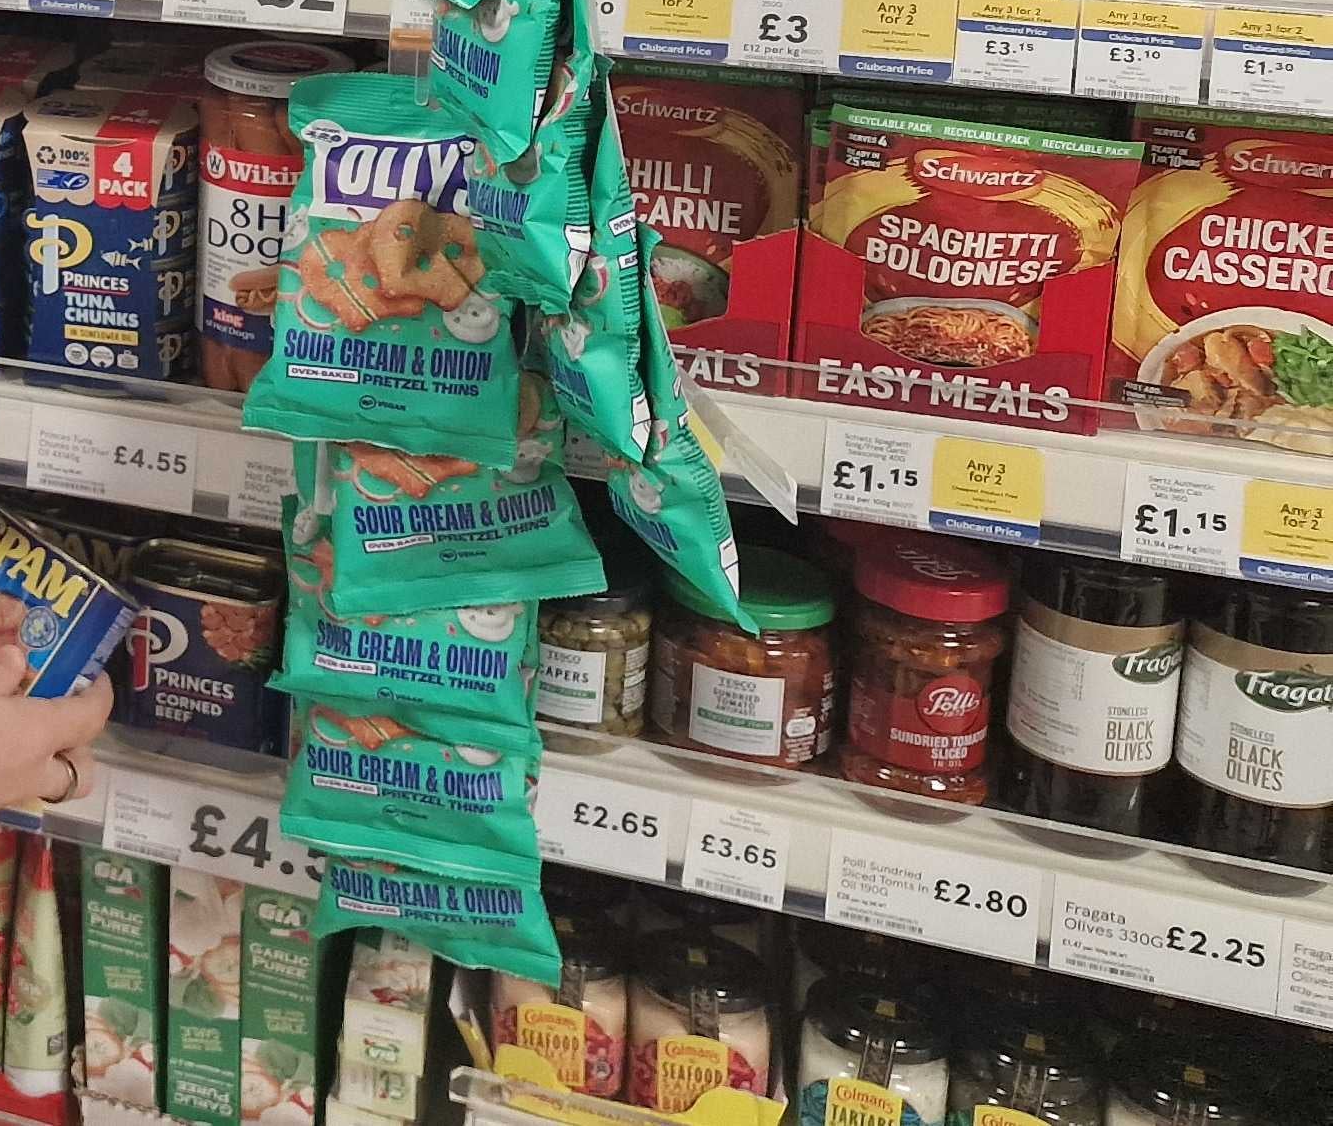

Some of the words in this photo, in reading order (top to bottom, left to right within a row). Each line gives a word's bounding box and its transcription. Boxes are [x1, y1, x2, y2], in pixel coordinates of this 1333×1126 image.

[759, 14, 808, 43] £3
[639, 43, 682, 54] Clubcard
[685, 45, 711, 56] Price
[985, 40, 1034, 56] £3.15
[1110, 47, 1160, 63] £3.10
[1244, 60, 1294, 75] £1.30
[919, 159, 1036, 186] Schwartz
[879, 214, 1059, 259] SPAGHETTI
[866, 237, 1062, 288] BOLOGNESE
[285, 329, 336, 362] SOUR
[341, 338, 406, 372] CREAM
[413, 345, 425, 374] &
[431, 350, 491, 381] ONION
[291, 368, 356, 380] OVEN-BAKED
[362, 375, 428, 391] PRETZEL
[434, 382, 479, 396] THINS
[817, 358, 921, 404] EASY
[929, 370, 1070, 422] MEALS
[114, 446, 188, 474] £4.55
[832, 460, 918, 492] £1.15
[1134, 504, 1227, 537] £1.15
[155, 667, 235, 699] PRINCES
[156, 693, 222, 718] CORNED
[156, 705, 191, 723] BEEF
[890, 728, 948, 748] SUNDRIED
[1106, 720, 1152, 740] BLACK
[1105, 741, 1152, 762] OLIVES
[1228, 738, 1283, 770] BLACK
[1226, 758, 1283, 792] OLIVES
[573, 802, 658, 838] £2.65
[700, 834, 777, 869] £3.65
[933, 880, 1028, 918] £2.80
[1066, 901, 1126, 926] Fragata
[1064, 918, 1113, 939] Olives
[1119, 928, 1164, 949] 330G
[1166, 926, 1265, 968] £2.25
[662, 1062, 723, 1085] SEAFOOD
